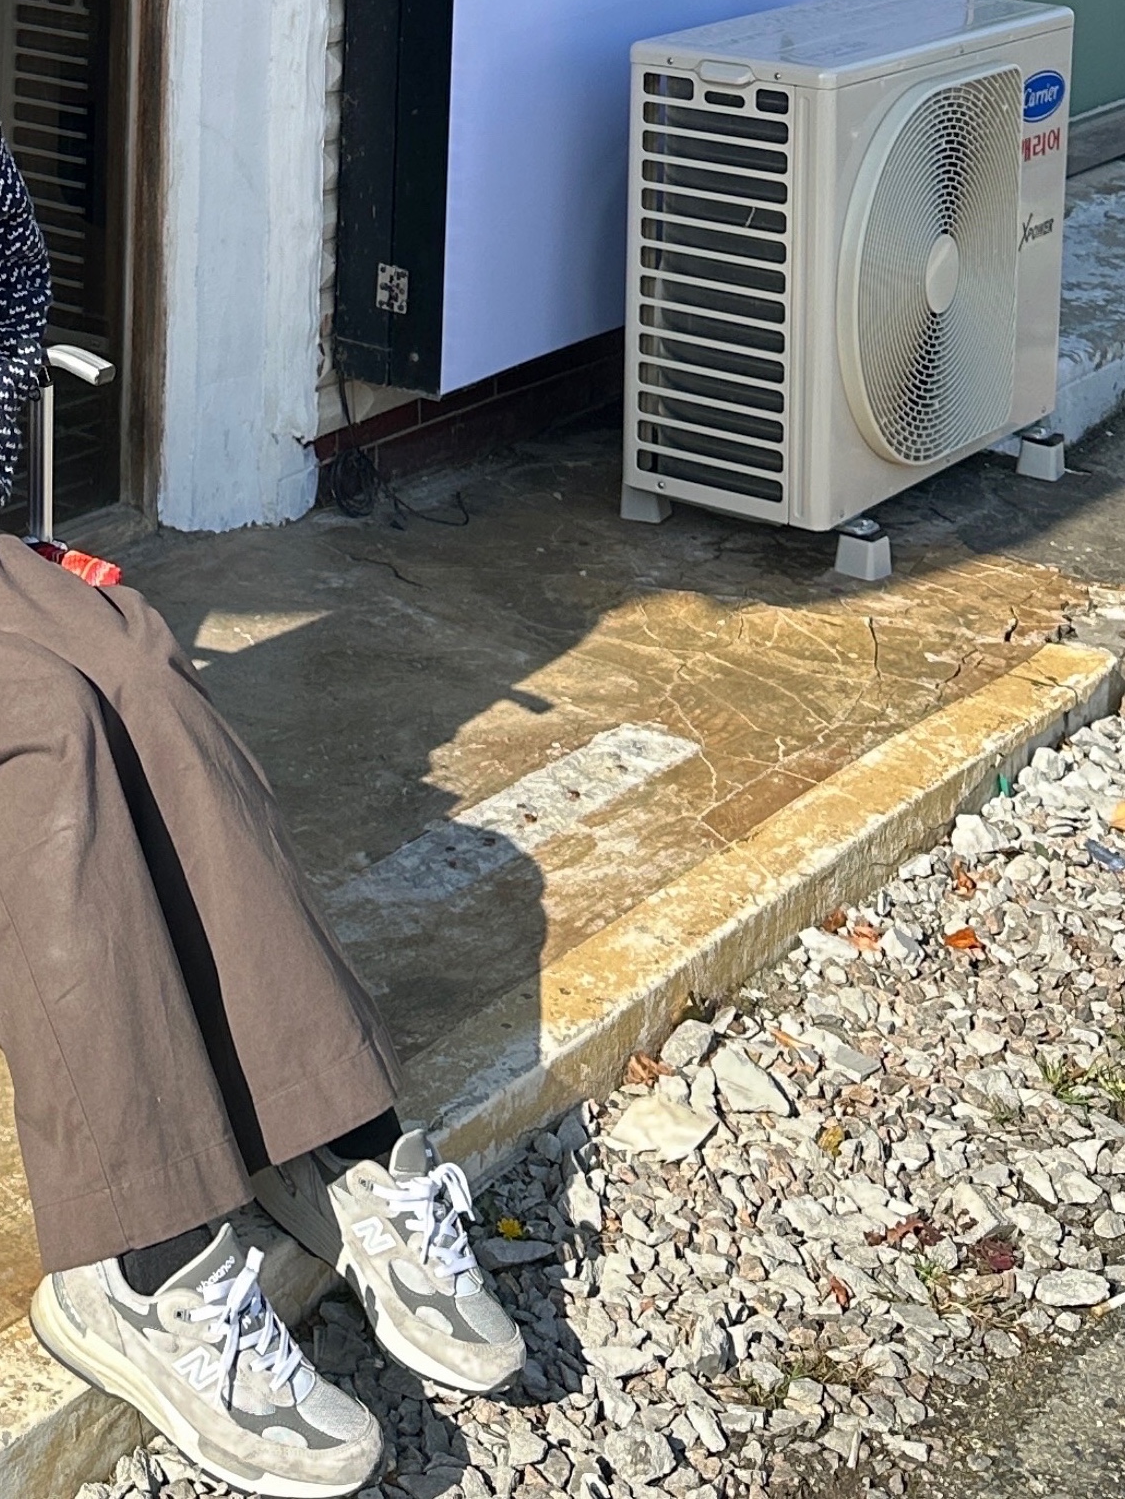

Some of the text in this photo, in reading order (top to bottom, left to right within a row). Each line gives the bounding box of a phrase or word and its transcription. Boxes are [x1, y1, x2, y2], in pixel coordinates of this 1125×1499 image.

[1024, 83, 1060, 109] Carrier
[351, 1216, 397, 1256] N
[172, 1345, 221, 1391] N
